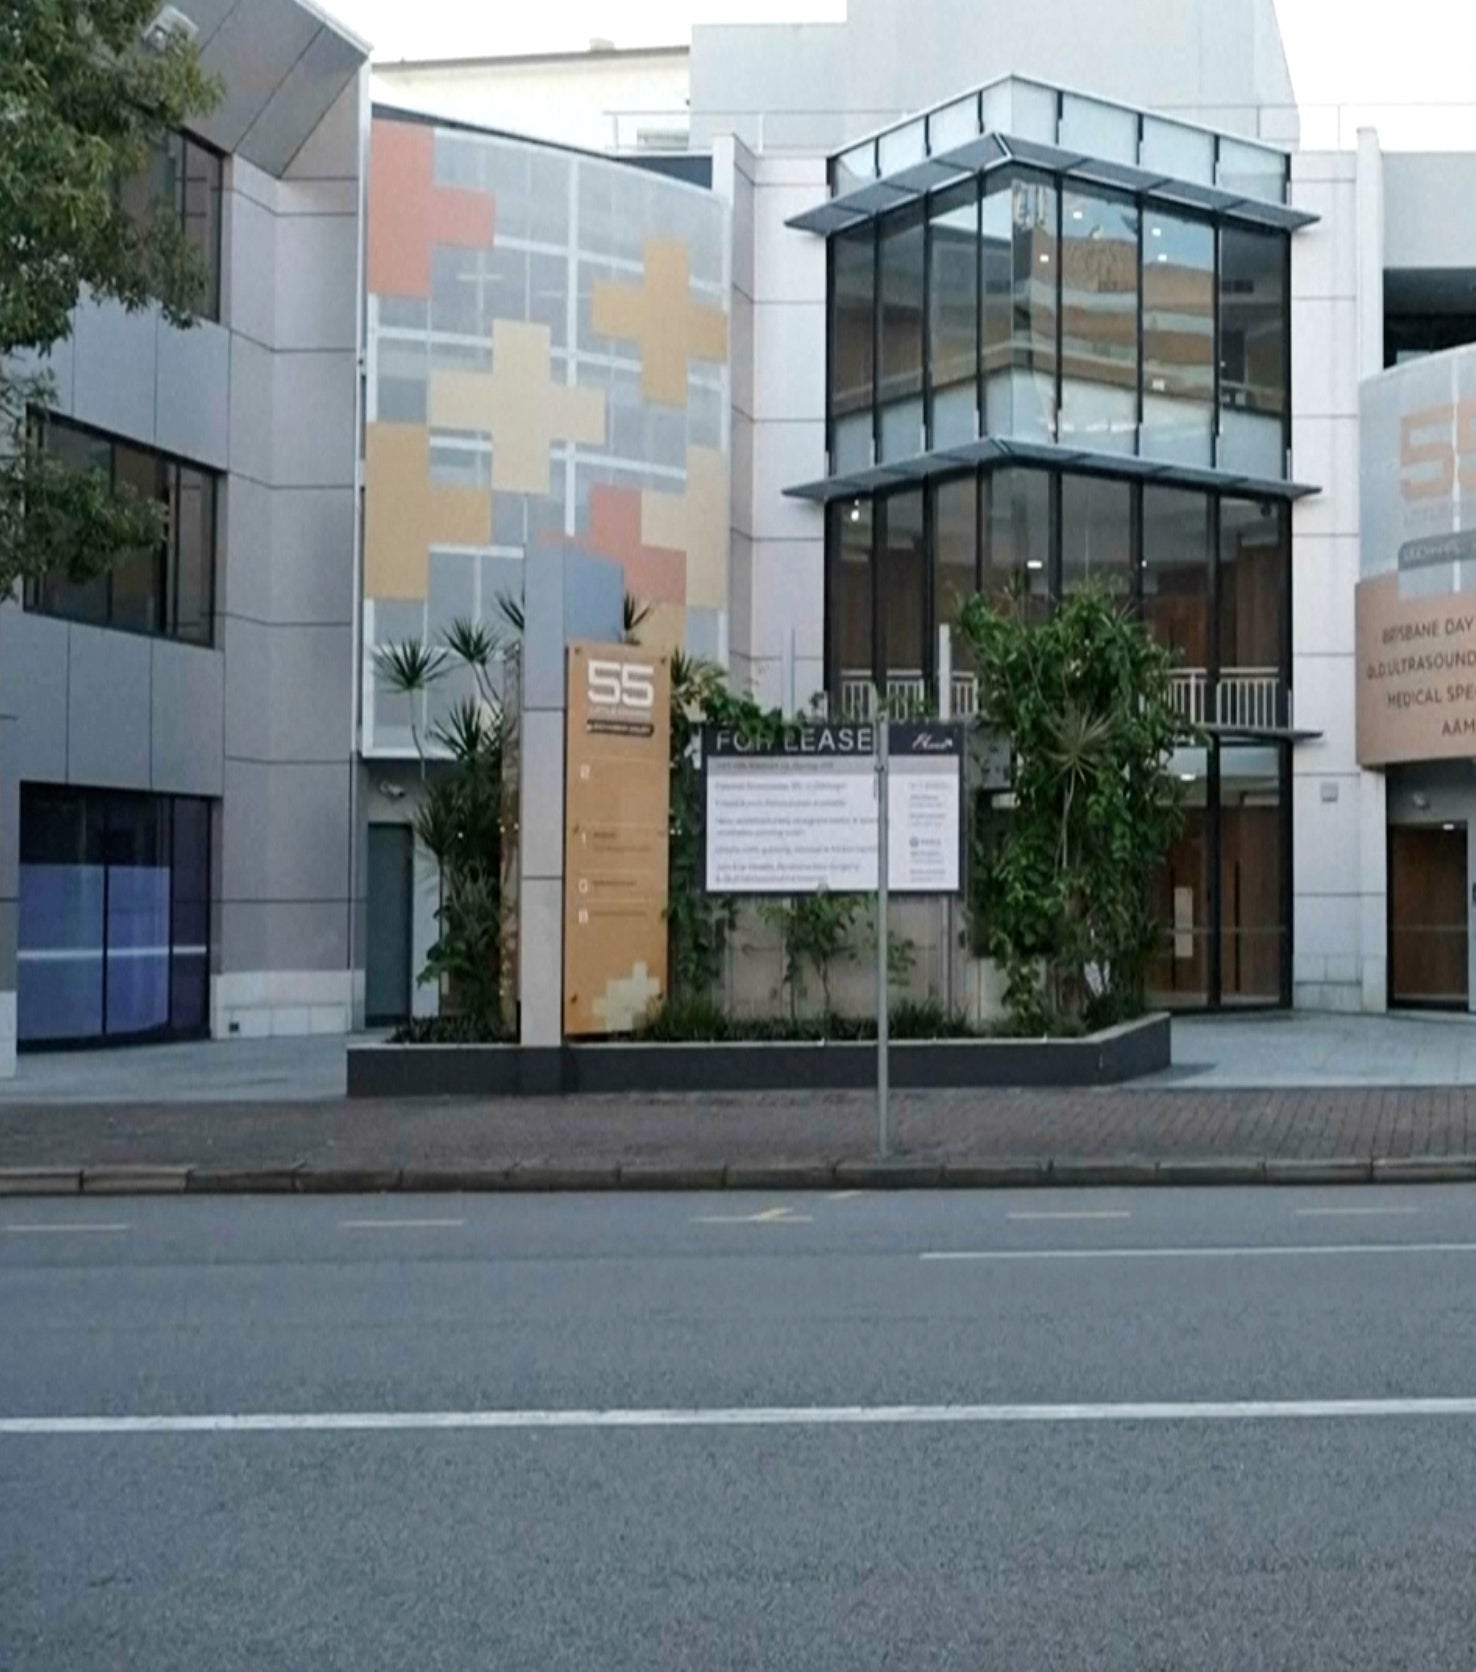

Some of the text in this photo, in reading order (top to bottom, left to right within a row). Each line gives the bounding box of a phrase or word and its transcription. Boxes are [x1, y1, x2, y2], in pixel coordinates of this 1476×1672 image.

[1382, 619, 1438, 645] BRISBANE
[1445, 616, 1474, 635] DAY
[588, 660, 654, 707] 55
[1387, 688, 1442, 709] MEDICAL
[1441, 718, 1476, 736] AAM
[784, 728, 873, 751] LEASE
